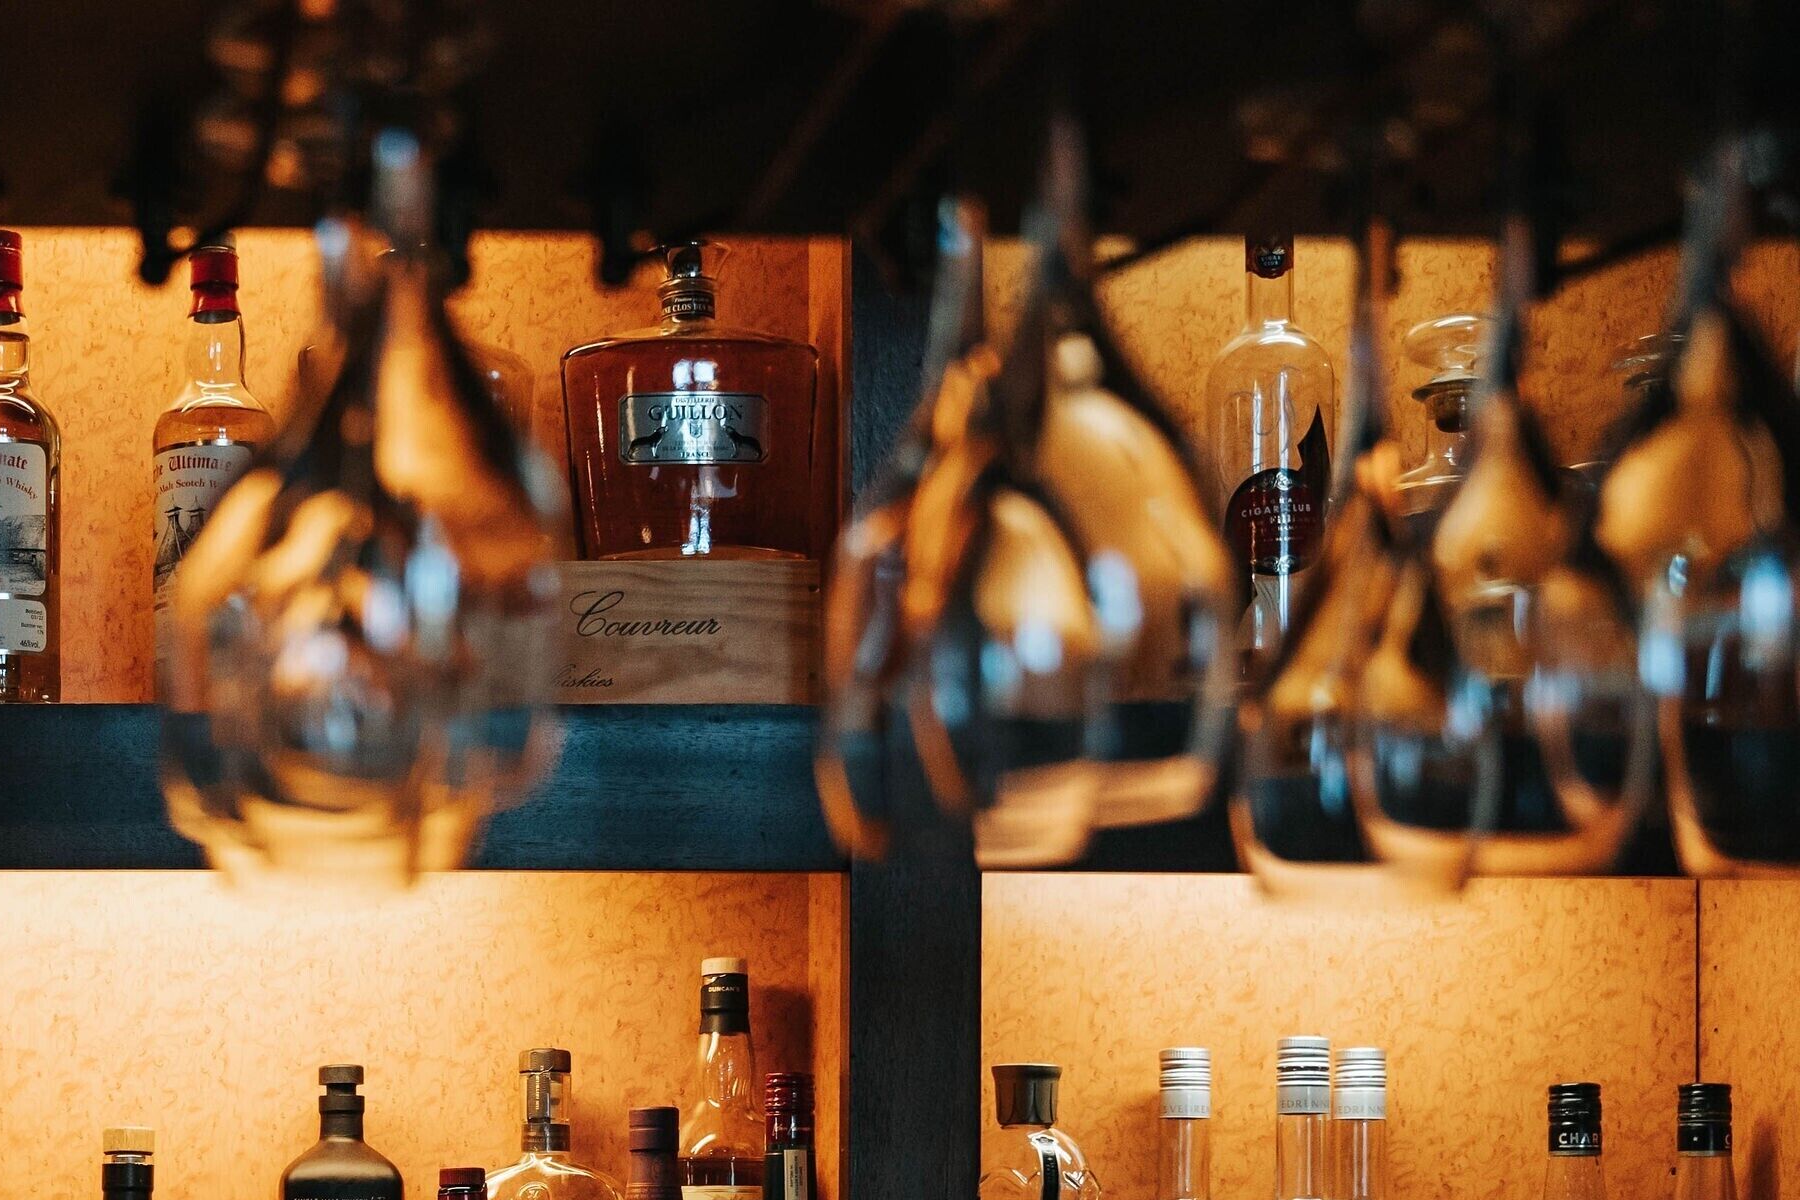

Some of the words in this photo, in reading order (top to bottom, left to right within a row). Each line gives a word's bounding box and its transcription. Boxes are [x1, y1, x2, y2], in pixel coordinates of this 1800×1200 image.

[647, 403, 744, 422] GUILLON
[6, 477, 39, 500] Whisky
[176, 477, 205, 488] Scotch
[1241, 506, 1280, 518] CIGAR
[569, 590, 722, 637] Couvreur
